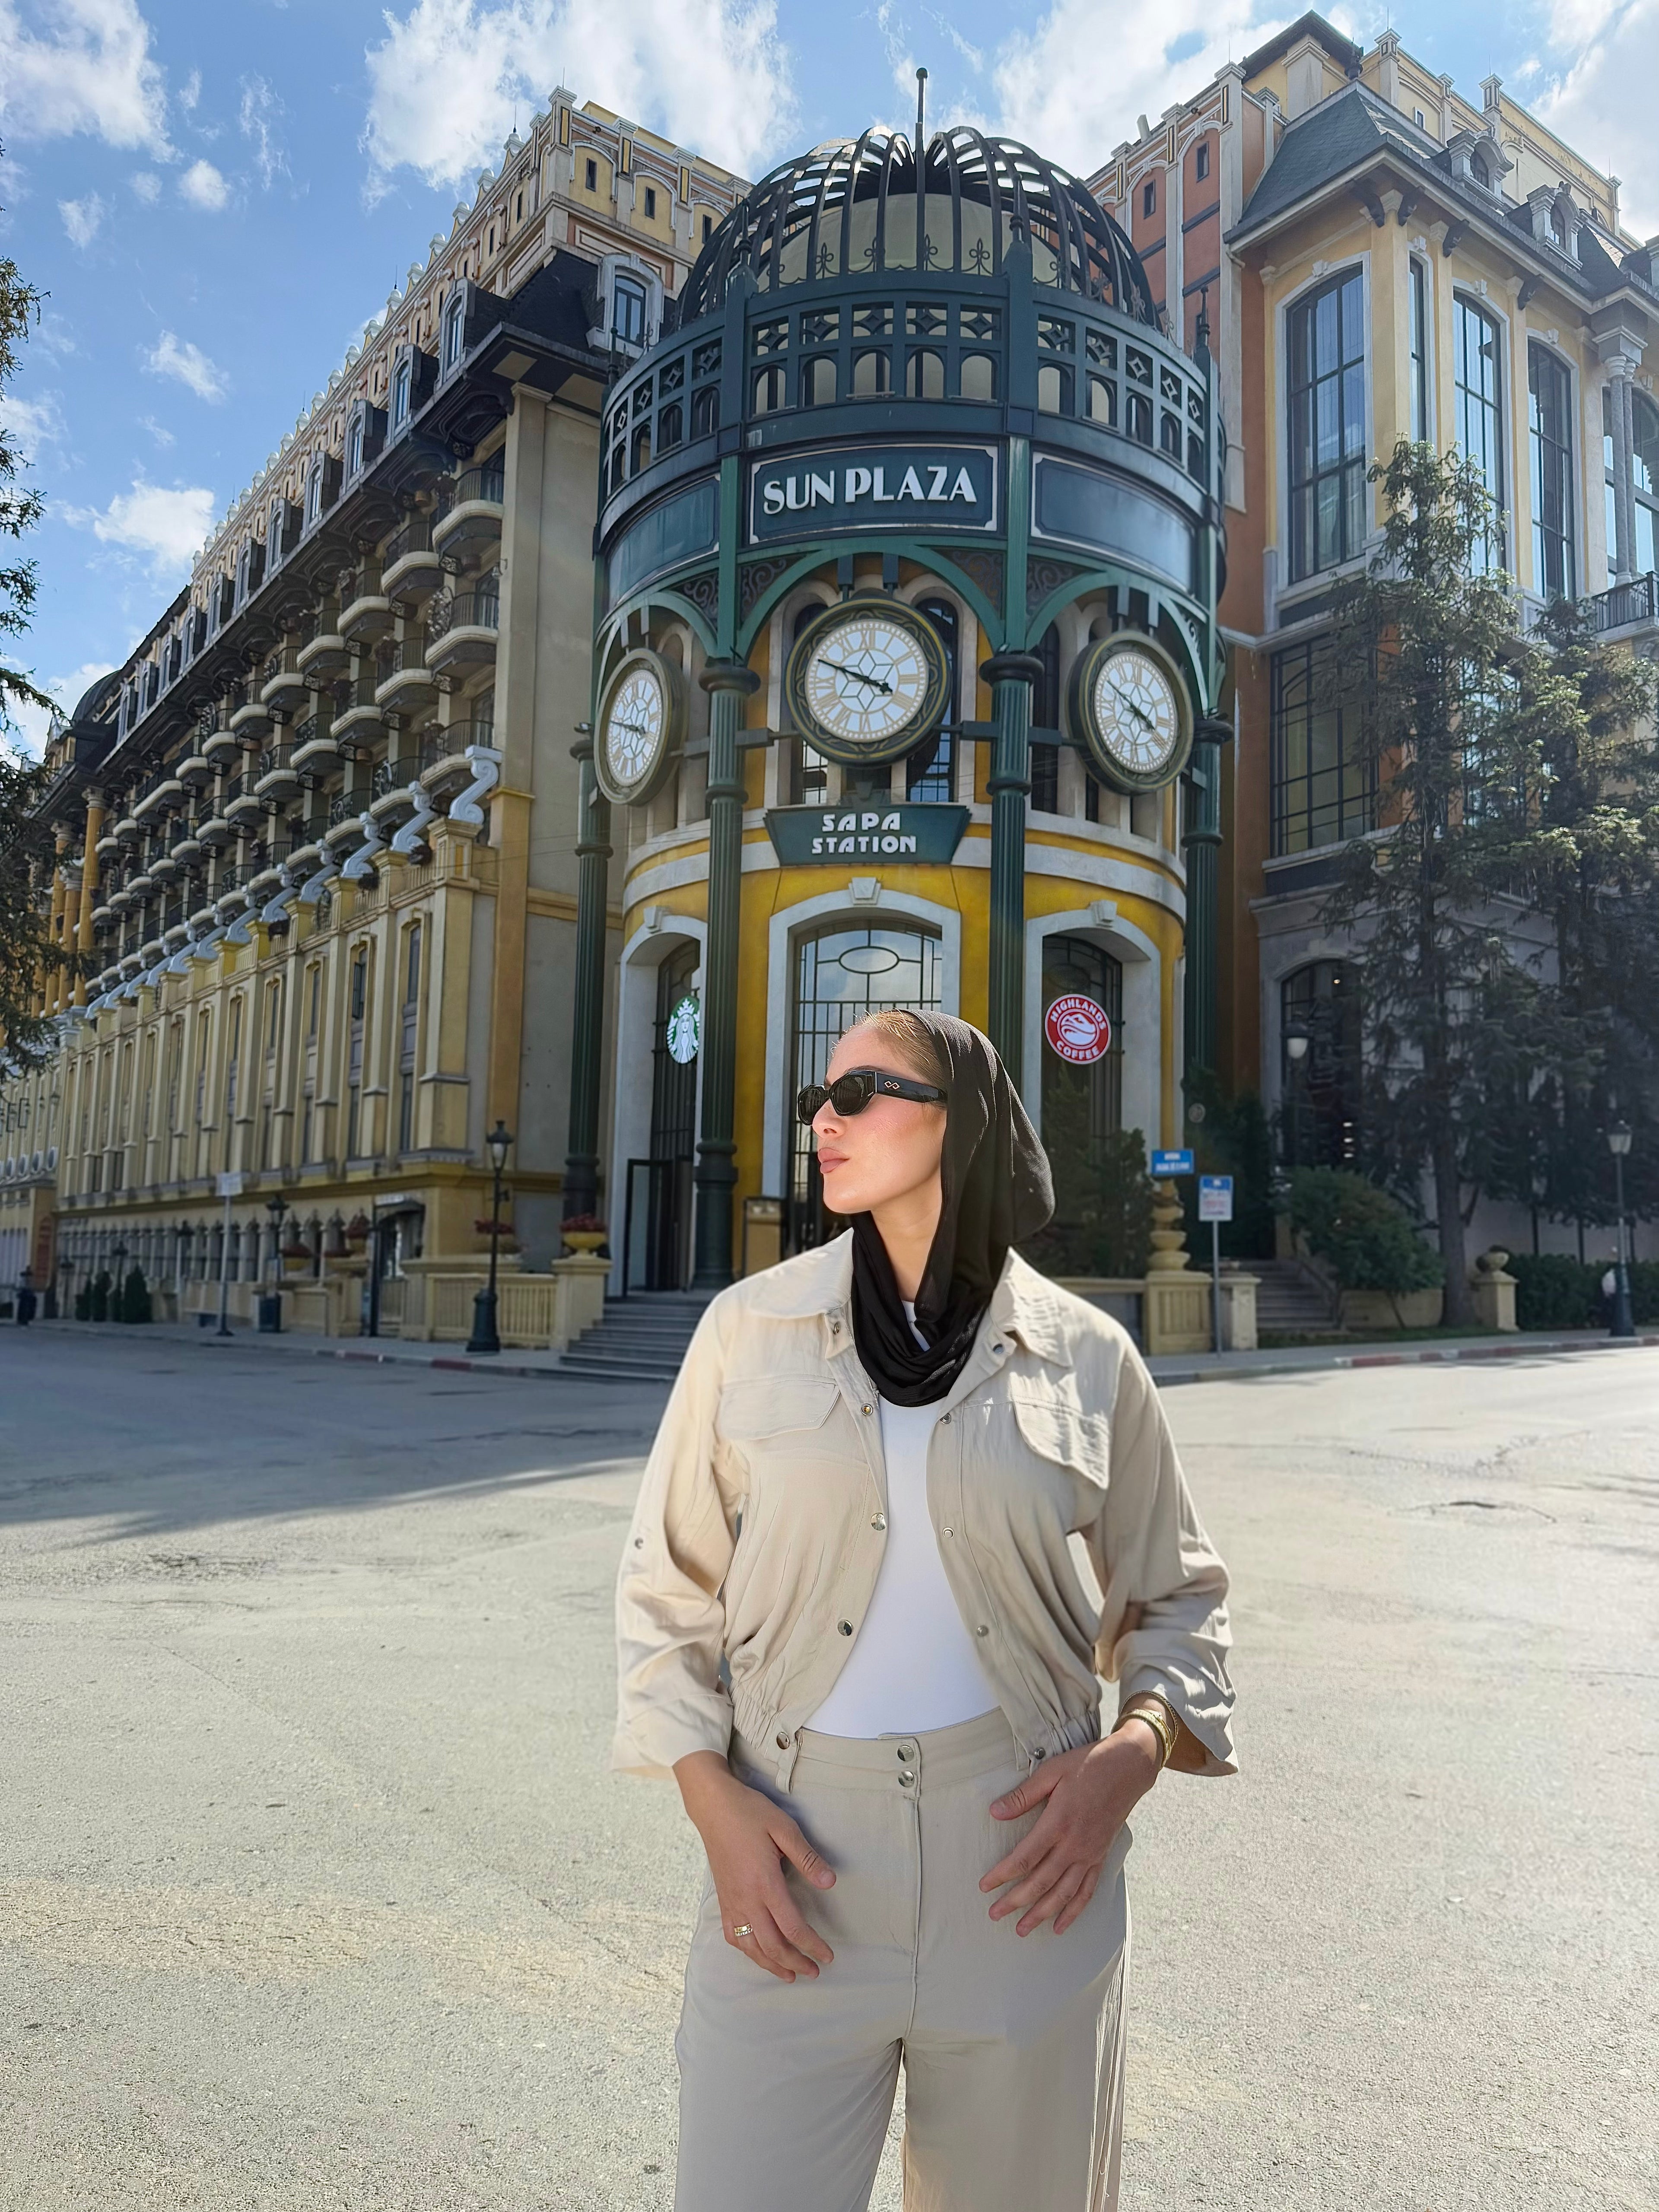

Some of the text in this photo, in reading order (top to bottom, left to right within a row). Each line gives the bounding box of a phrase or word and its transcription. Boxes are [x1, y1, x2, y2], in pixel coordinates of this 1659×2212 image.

[763, 466, 977, 515] SUN PLAZA
[822, 812, 901, 832] SAPA
[812, 836, 916, 854] STATION
[1050, 998, 1106, 1030] HIGHLANDS
[1056, 1040, 1100, 1060] COFFEE
